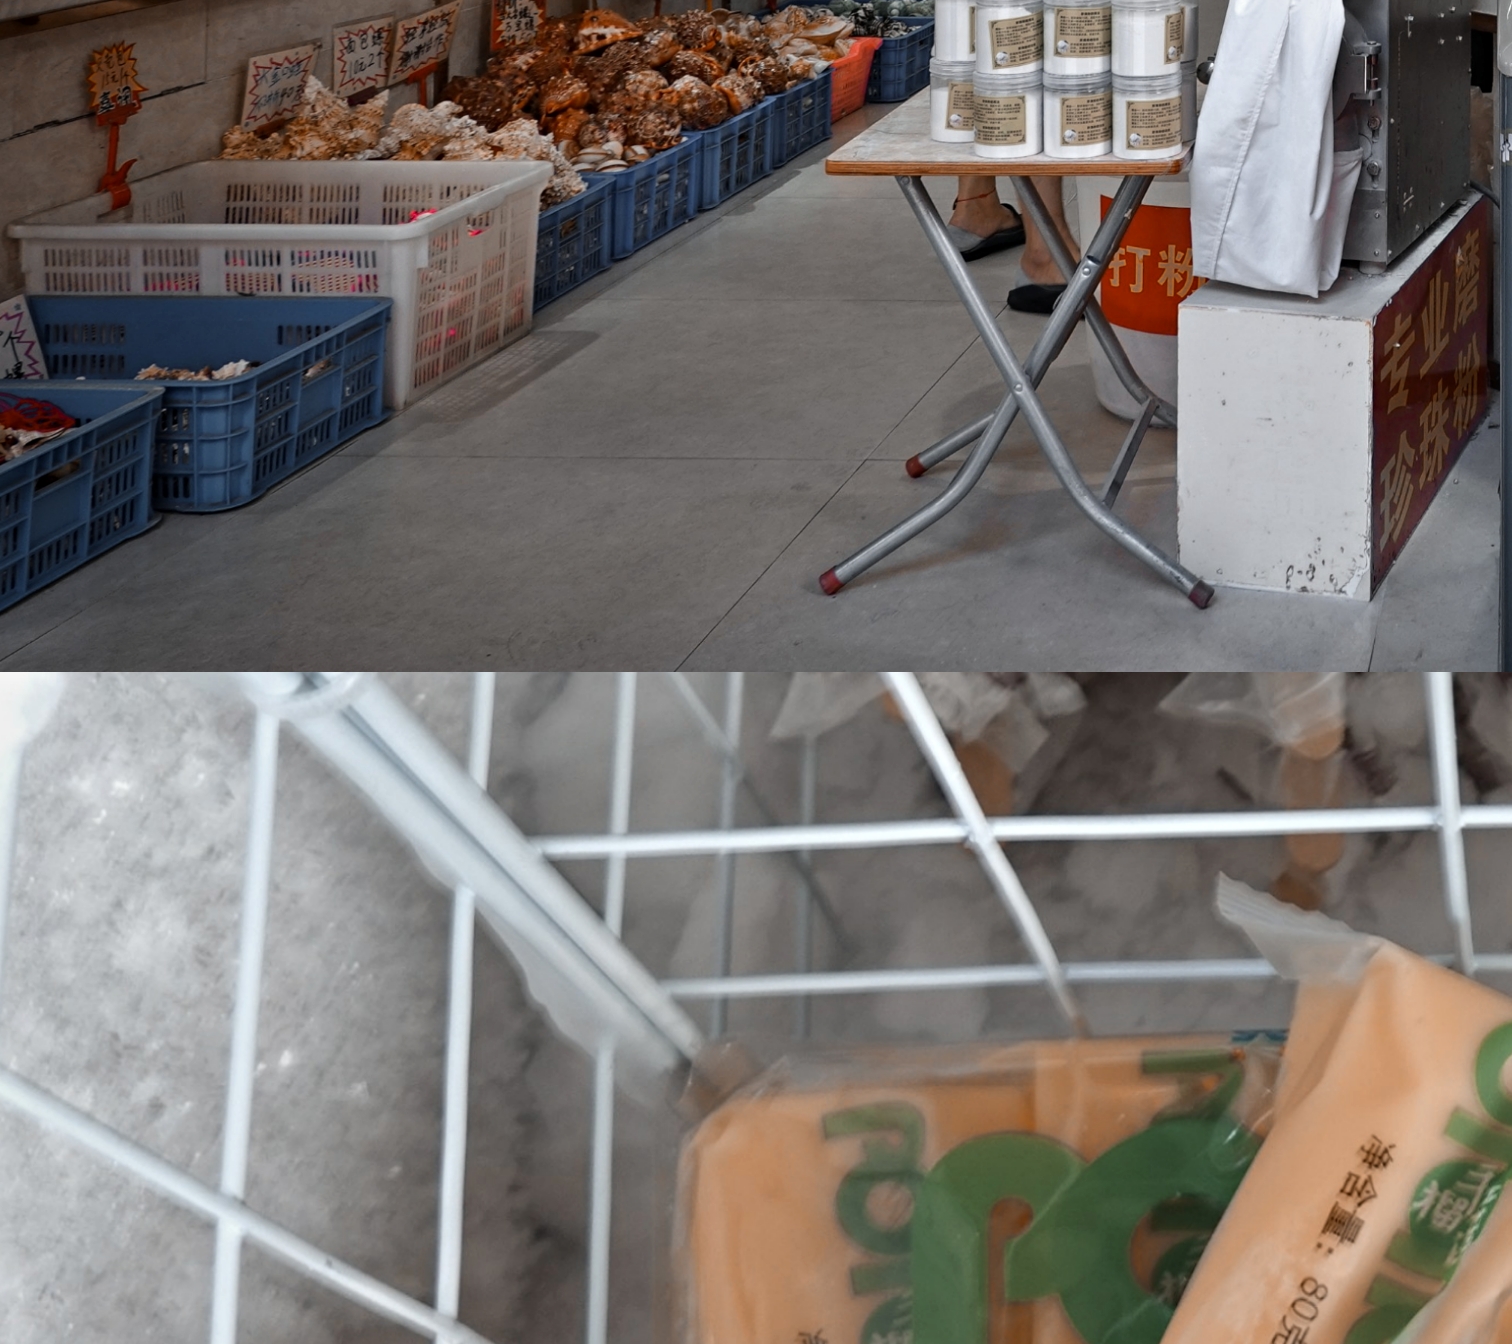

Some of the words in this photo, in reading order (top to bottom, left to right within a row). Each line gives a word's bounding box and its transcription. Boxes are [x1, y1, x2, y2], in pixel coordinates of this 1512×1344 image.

[1380, 228, 1481, 414] 专业磨
[1377, 335, 1480, 551] 珍珠粉
